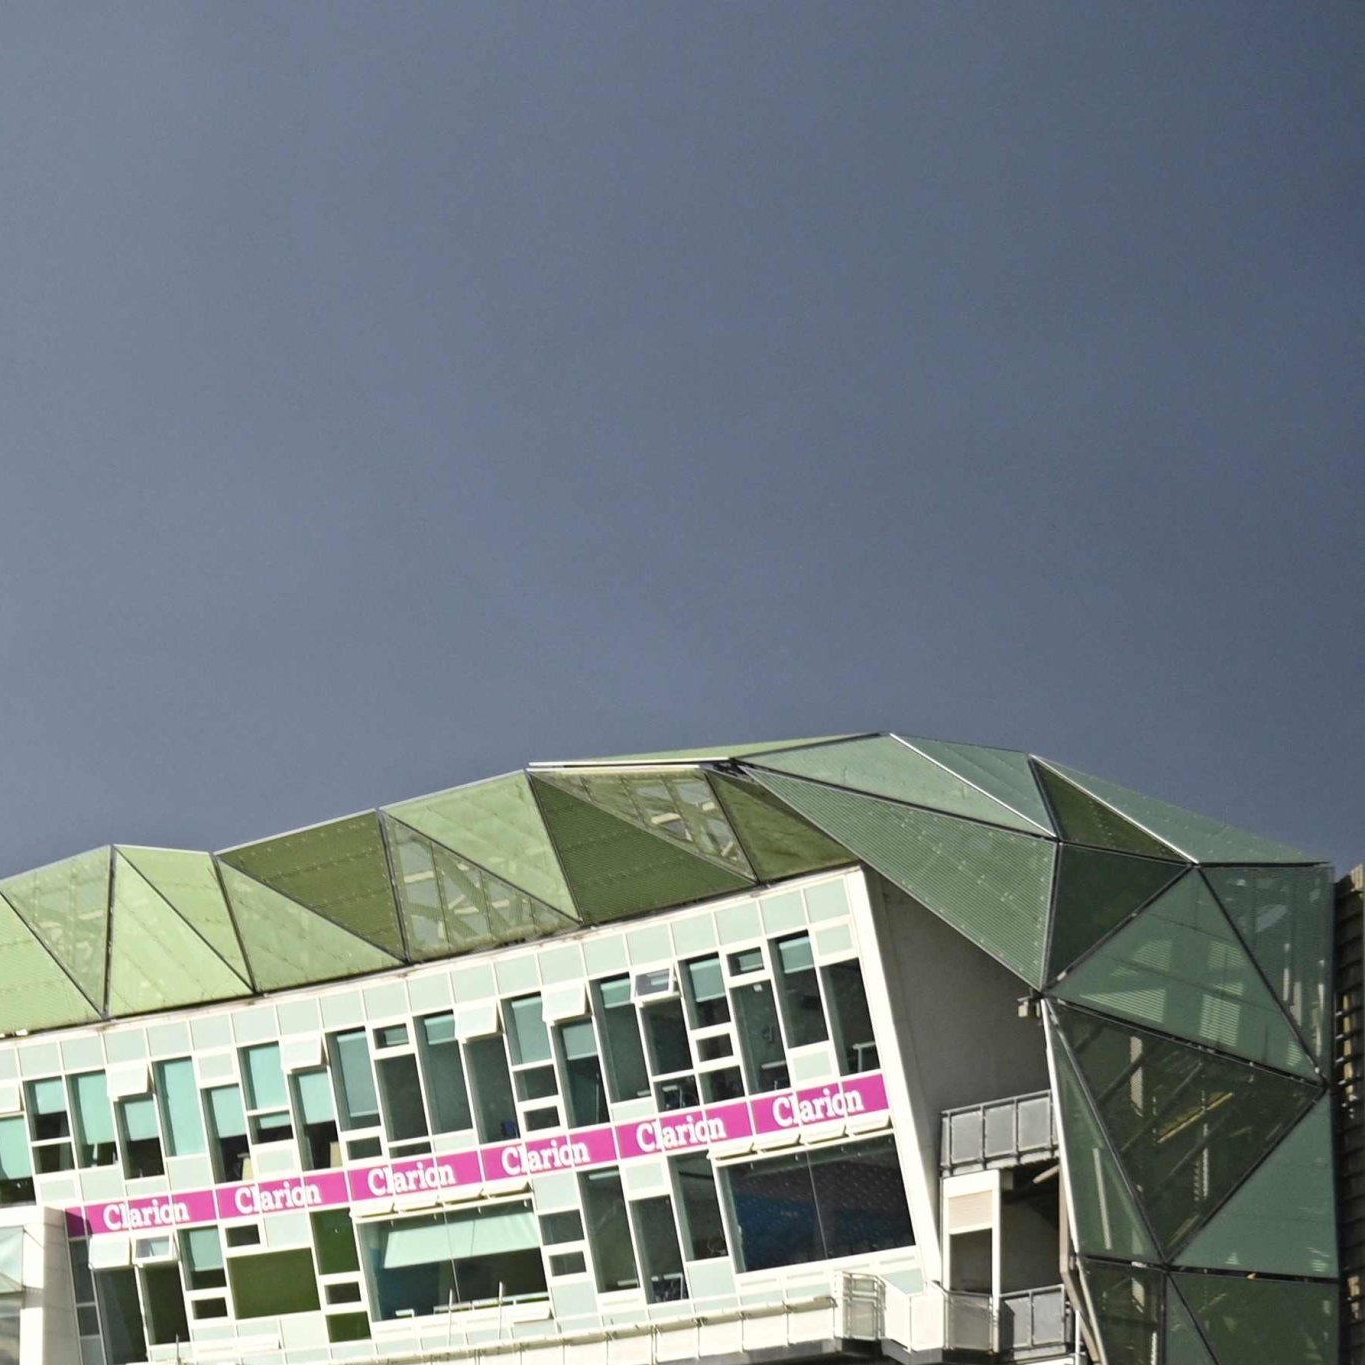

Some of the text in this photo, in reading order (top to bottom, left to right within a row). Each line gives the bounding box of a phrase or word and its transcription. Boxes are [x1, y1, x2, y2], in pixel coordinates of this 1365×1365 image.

[772, 1087, 864, 1127] Clarion
[637, 1114, 727, 1153] Clarion
[501, 1139, 590, 1176] Clarion
[235, 1178, 322, 1215] Clarion
[368, 1161, 456, 1196] Clarion
[103, 1199, 190, 1231] Clarion
